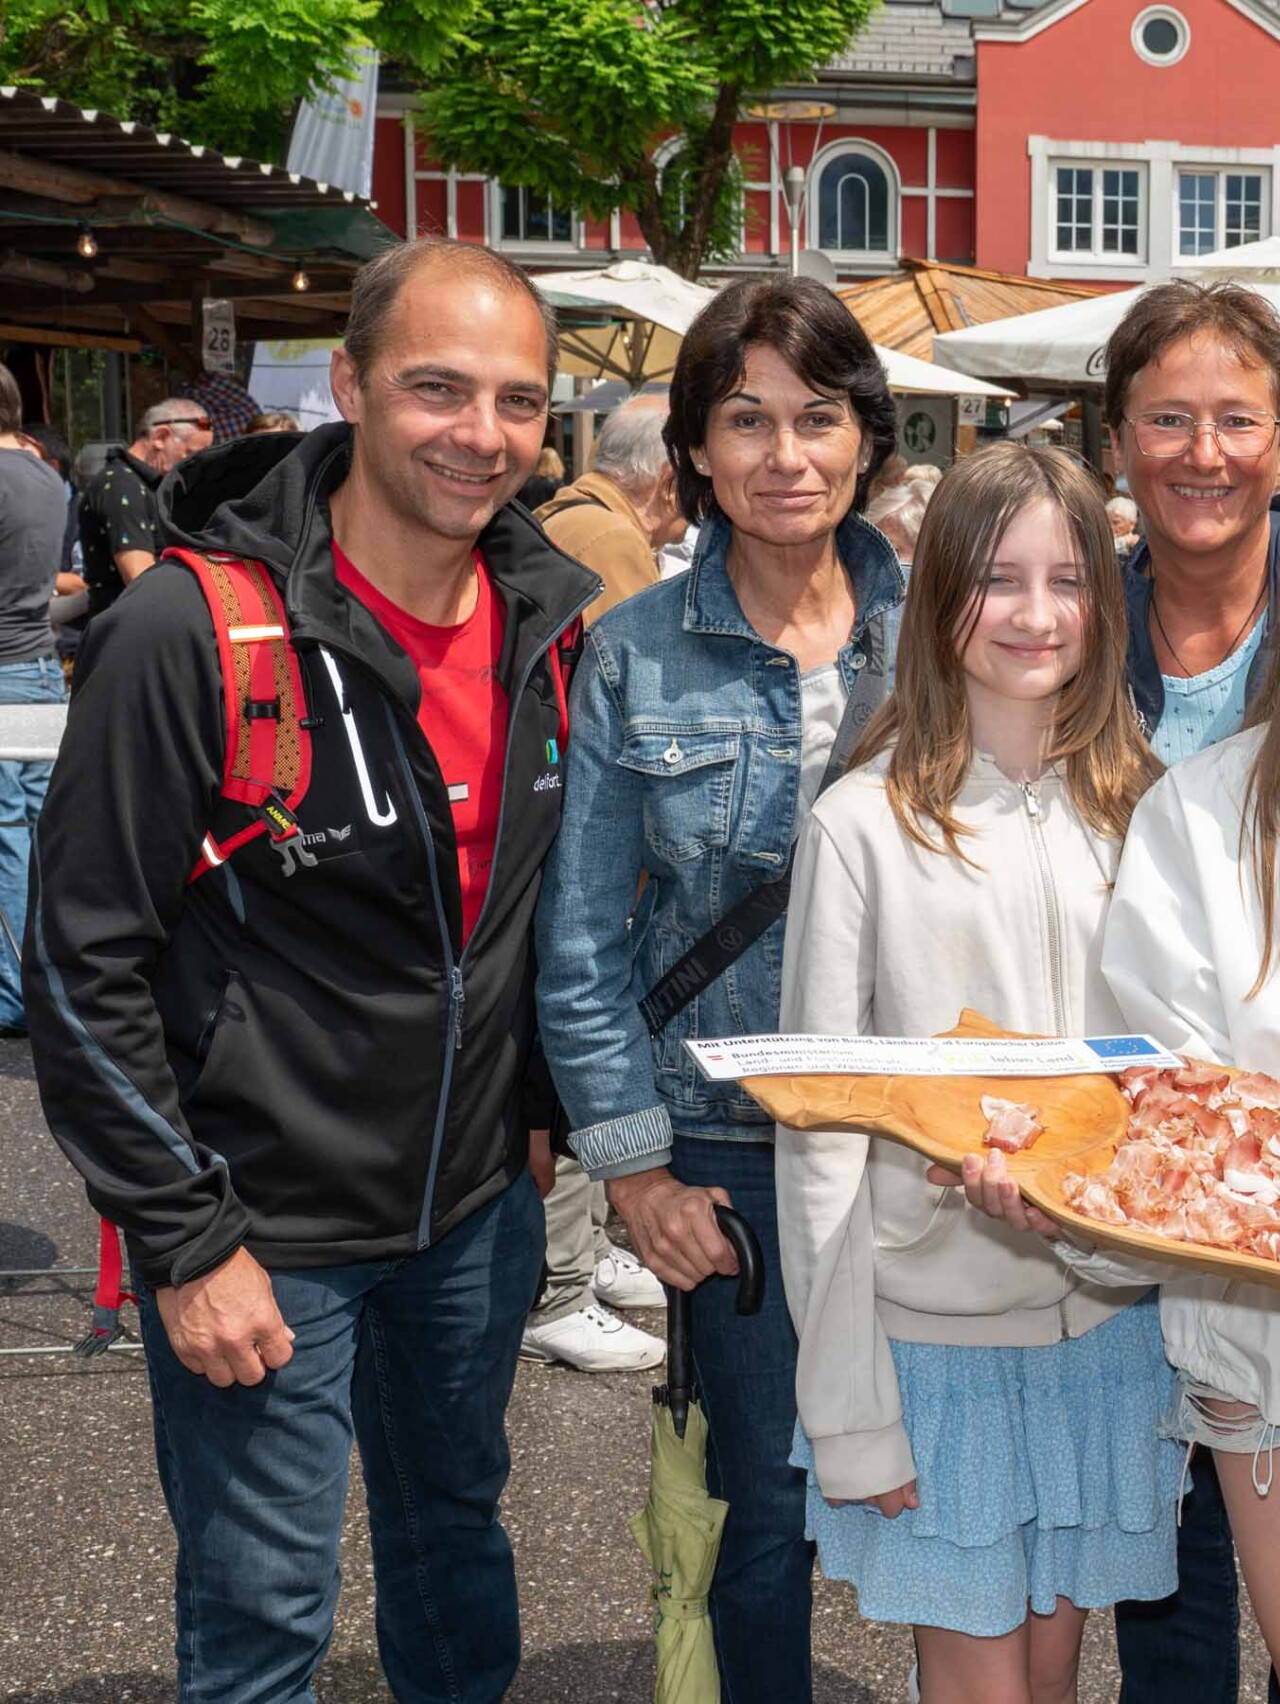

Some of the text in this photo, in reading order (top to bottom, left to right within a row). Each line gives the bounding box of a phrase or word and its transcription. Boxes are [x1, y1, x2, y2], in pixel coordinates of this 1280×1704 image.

[963, 400, 981, 414] 27
[302, 831, 327, 846] ma
[697, 1041, 720, 1049] Mit
[723, 1036, 814, 1047] Unterstützung
[841, 1037, 879, 1046] Bund,
[879, 1038, 928, 1046] Ländern
